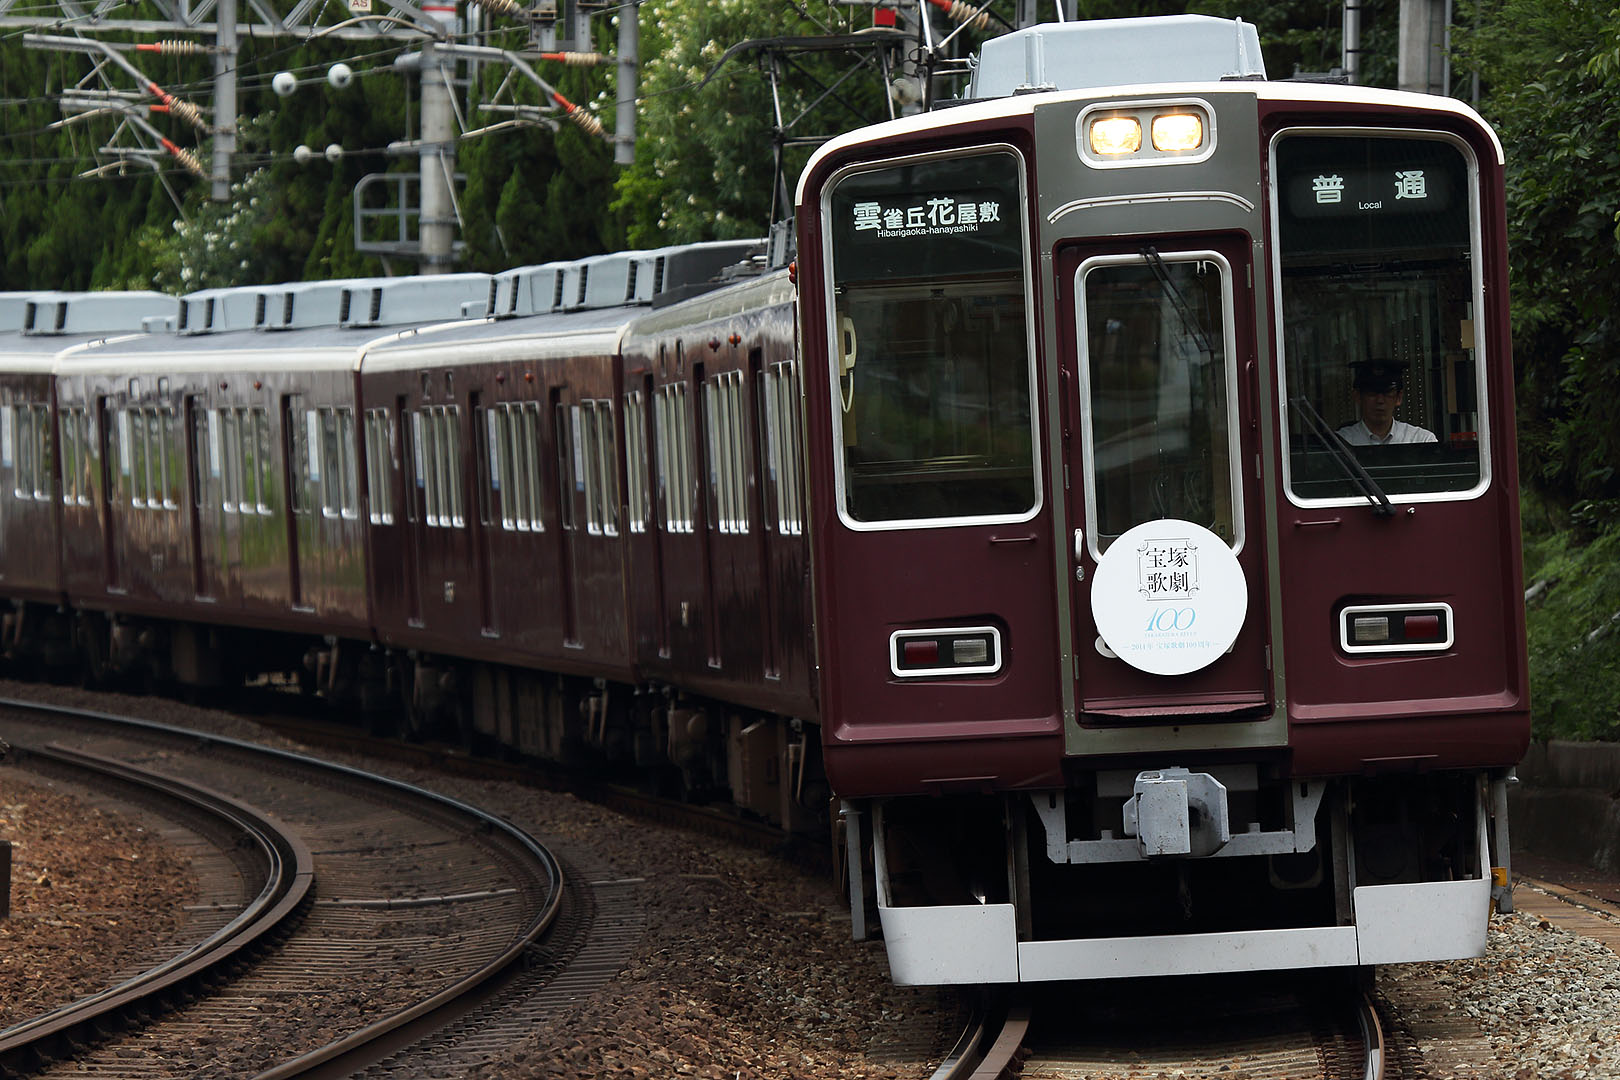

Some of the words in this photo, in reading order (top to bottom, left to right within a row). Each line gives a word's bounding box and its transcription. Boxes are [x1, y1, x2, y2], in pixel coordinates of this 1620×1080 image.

[853, 197, 1001, 231] 雲雀丘花屋敷
[1358, 200, 1382, 210] Local
[877, 223, 979, 238] Hibarigaoka-hanayashiki
[1145, 547, 1190, 568] 宝塚
[1146, 571, 1190, 593] 歌劇
[1144, 607, 1197, 632] 100
